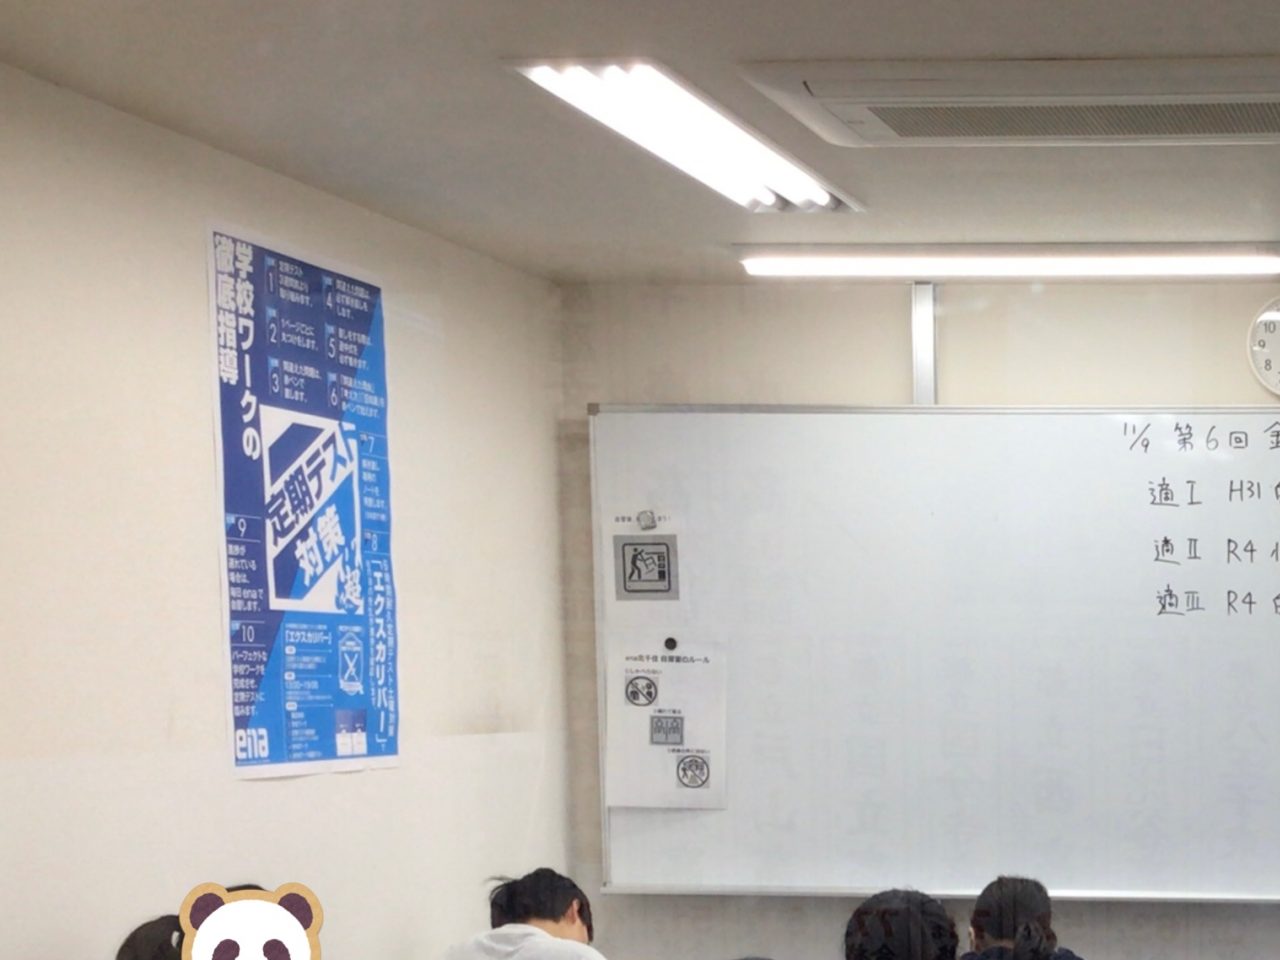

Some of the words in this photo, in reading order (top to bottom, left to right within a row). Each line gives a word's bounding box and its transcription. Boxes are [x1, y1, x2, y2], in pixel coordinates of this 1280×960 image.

[1263, 321, 1277, 334] 10
[234, 240, 262, 461] 学校ワークの
[1263, 359, 1273, 372] 8
[266, 422, 355, 547] 定期テスト
[1228, 479, 1262, 502] H31
[295, 503, 345, 587] 対策
[1227, 538, 1257, 564] R4
[1227, 591, 1257, 616] R4
[241, 625, 255, 642] 10
[235, 727, 270, 760] ena
